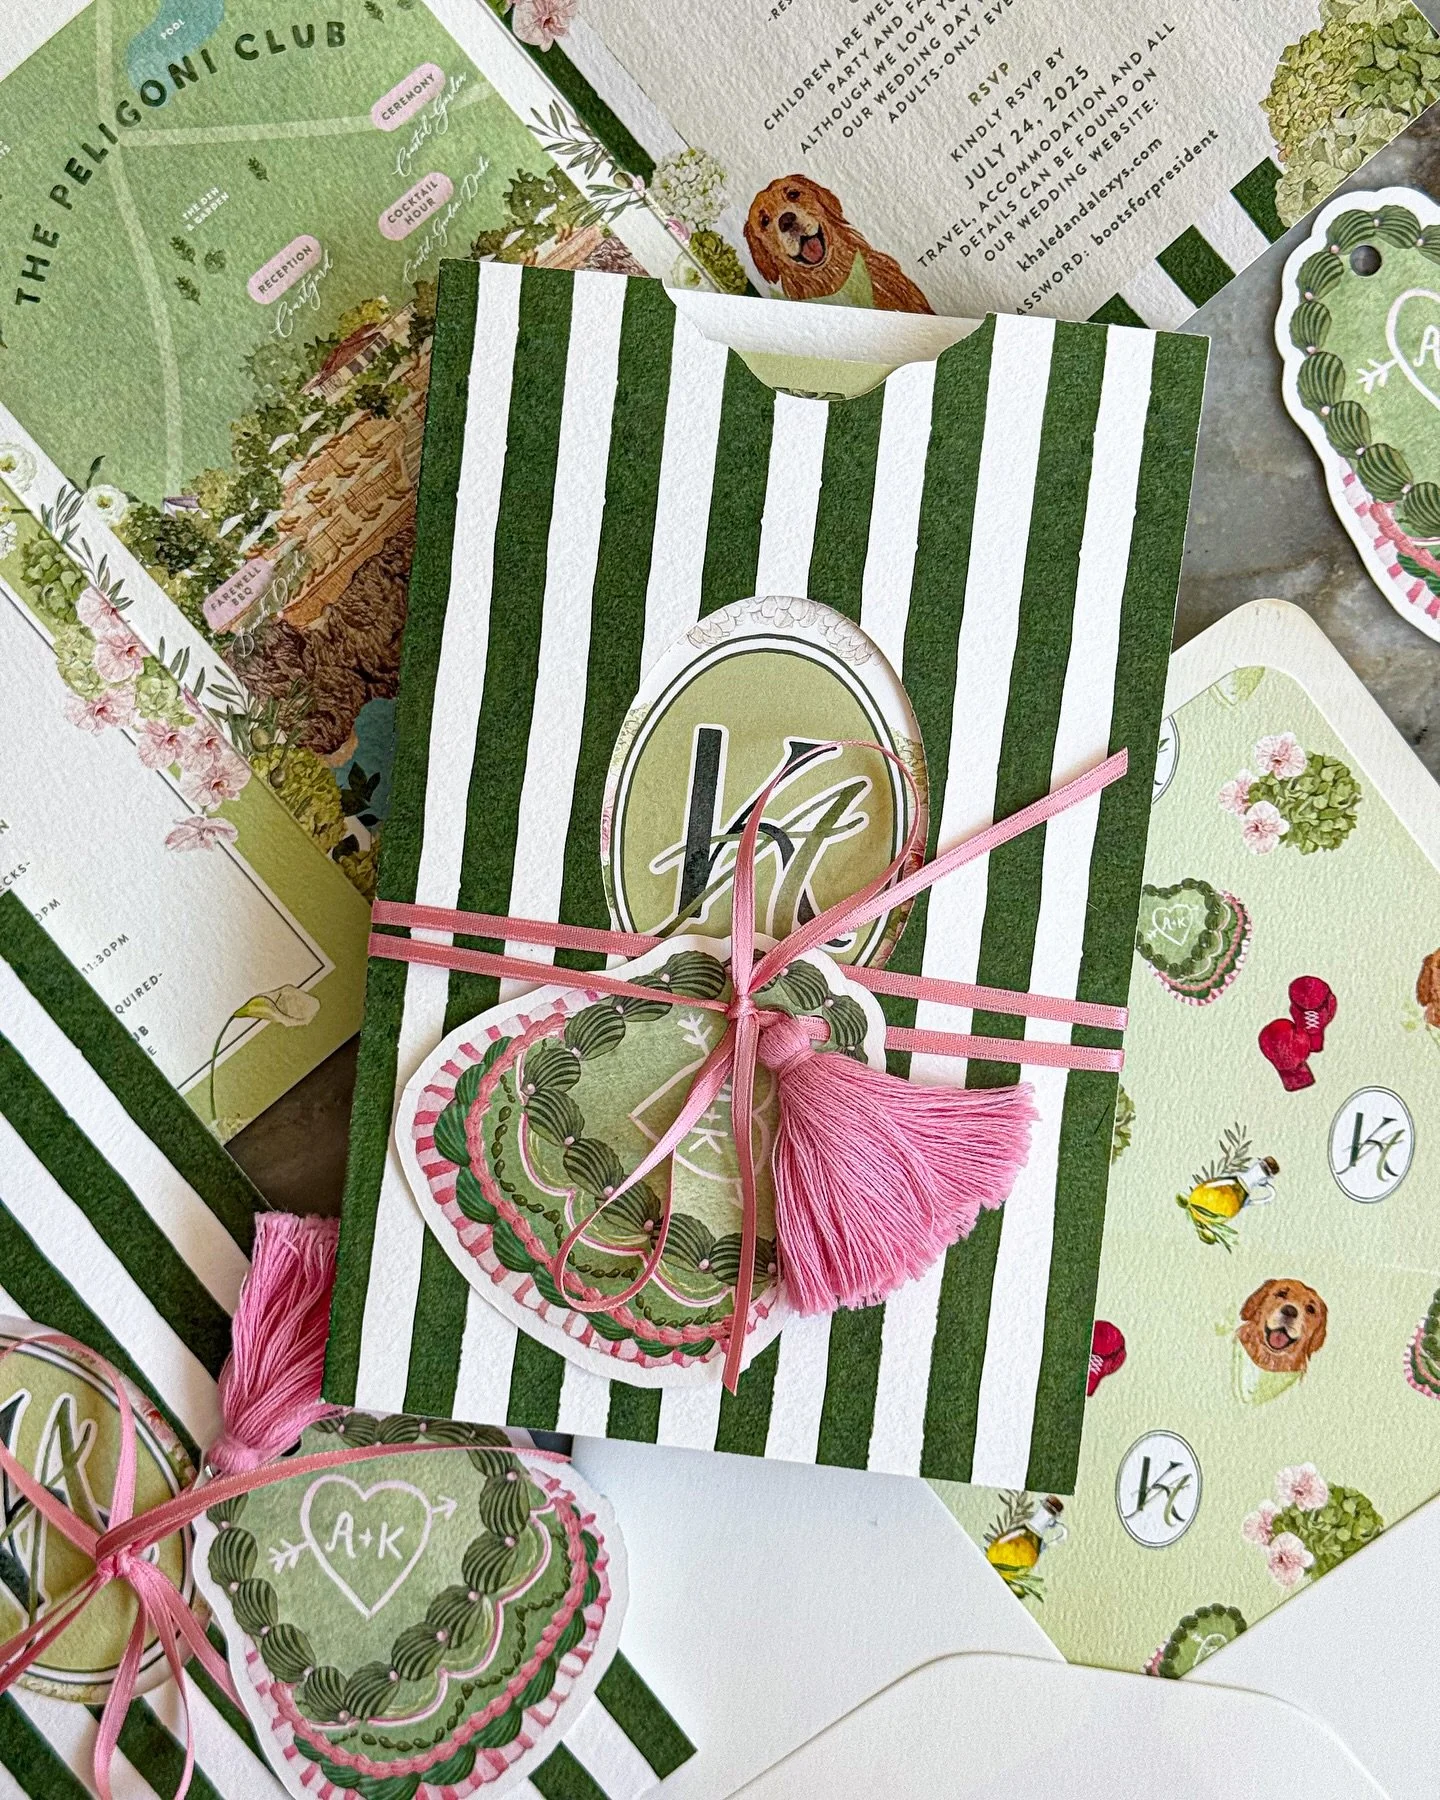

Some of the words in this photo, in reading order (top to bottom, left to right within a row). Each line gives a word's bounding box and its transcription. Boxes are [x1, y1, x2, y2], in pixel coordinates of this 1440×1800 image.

[160, 19, 185, 40] POOL
[827, 48, 870, 95] PARTY
[873, 15, 903, 49] AND
[381, 73, 435, 120] CEREMONY
[764, 58, 832, 131] CHILDREN
[835, 27, 863, 60] ARE
[799, 77, 872, 154] ALTHOUGH
[873, 52, 897, 77] WE
[897, 12, 936, 53] LOVE
[842, 106, 873, 138] OUR
[874, 37, 941, 105] WEDDING
[943, 4, 972, 36] DAY
[888, 24, 982, 124] ADULTS-ONLY
[950, 108, 1002, 162] KINDLY
[1005, 69, 1042, 109] RSVP
[1045, 47, 1065, 70] BY
[967, 62, 1010, 107] RSVP
[15, 223, 60, 305] THE
[50, 48, 217, 210] PELIGONI
[234, 21, 345, 60] CLUB
[917, 217, 977, 268] TRAVEL,
[979, 85, 1107, 214] ACCOMMODATION
[1110, 51, 1142, 87] AND
[1146, 22, 1176, 51] ALL
[959, 201, 1018, 258] DETAILS
[1020, 167, 1052, 200] CAN
[1054, 146, 1074, 168] BE
[1075, 94, 1128, 147] FOUND
[1132, 67, 1157, 93] ON
[964, 143, 1006, 190] JULY
[1010, 118, 1044, 144] 24,
[1043, 65, 1089, 112] 2025
[182, 203, 200, 220] THE
[200, 187, 219, 205] DEN
[194, 191, 229, 224] GARDEN
[387, 180, 438, 224] COCKTAIL
[404, 197, 436, 225] HOUR
[984, 232, 1016, 262] OUR
[1017, 163, 1087, 230] WEDDING
[1088, 98, 1159, 162] WEBSITE:
[1016, 138, 1163, 273] khaledandalexys.com
[1090, 129, 1219, 247] bootsforpresident
[257, 245, 313, 294] RECEPTION
[211, 566, 262, 612] FAREWELL
[231, 587, 254, 607] BBQ
[81, 933, 130, 975] 11:30PM
[114, 971, 164, 1014] QUIRED-
